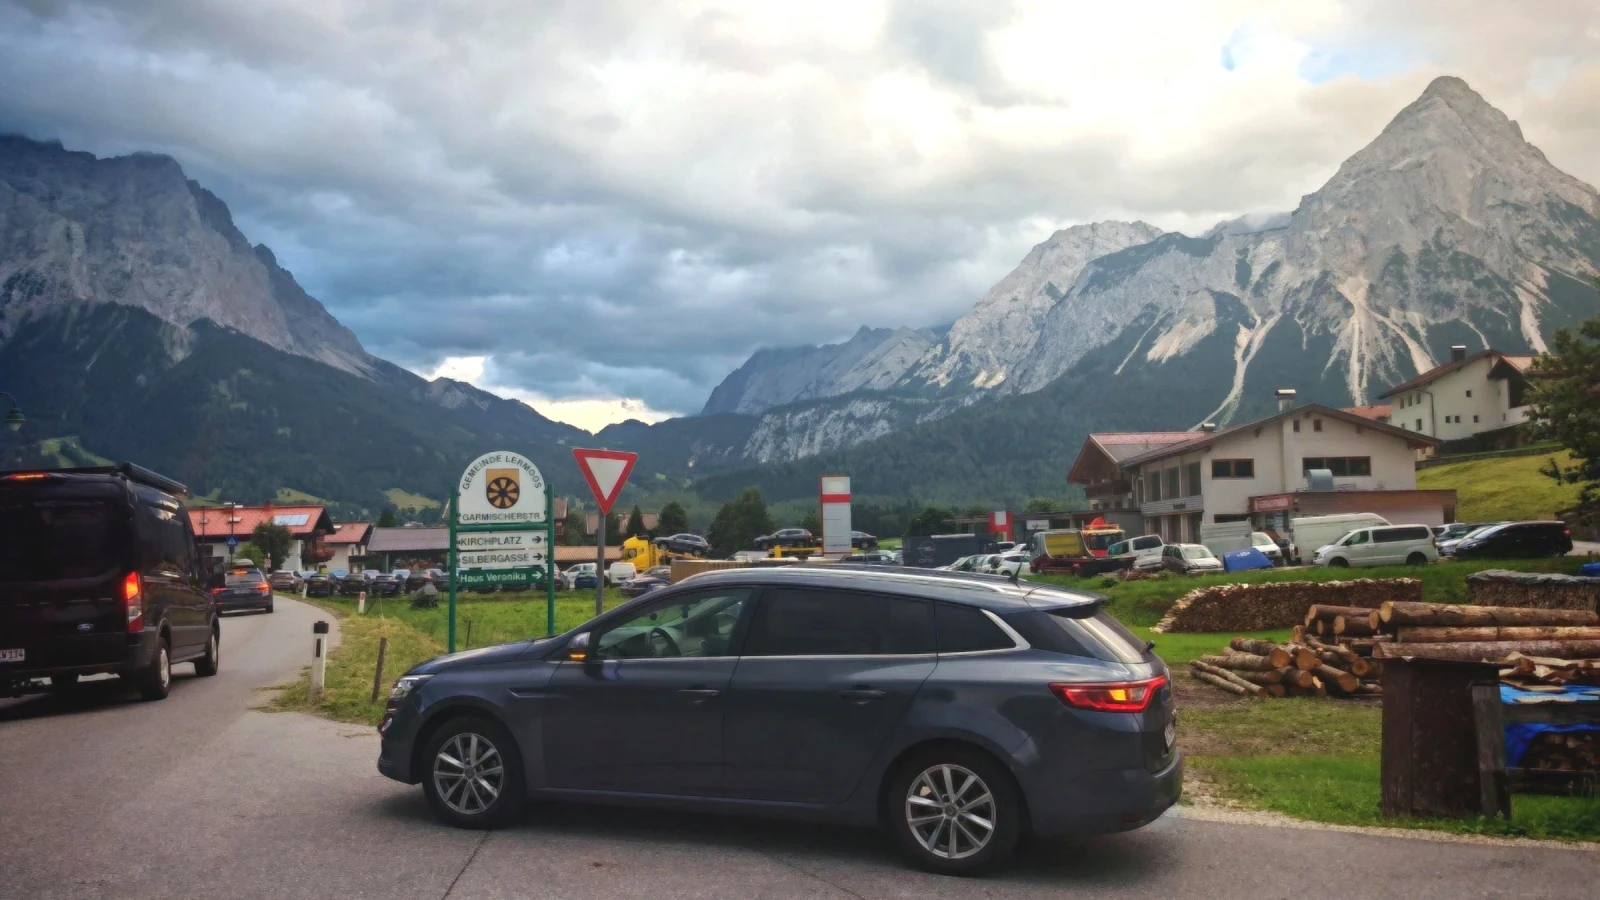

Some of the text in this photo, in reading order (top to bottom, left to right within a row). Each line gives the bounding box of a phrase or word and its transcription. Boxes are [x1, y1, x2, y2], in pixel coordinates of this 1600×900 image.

[462, 455, 542, 490] GEMEINDE LERMOOS
[462, 513, 542, 521] GARMISCHERSTR.
[460, 537, 522, 546] KIRCHPLATZ
[462, 554, 529, 564] SILBERGASSE
[460, 571, 527, 583] Haus Veronika
